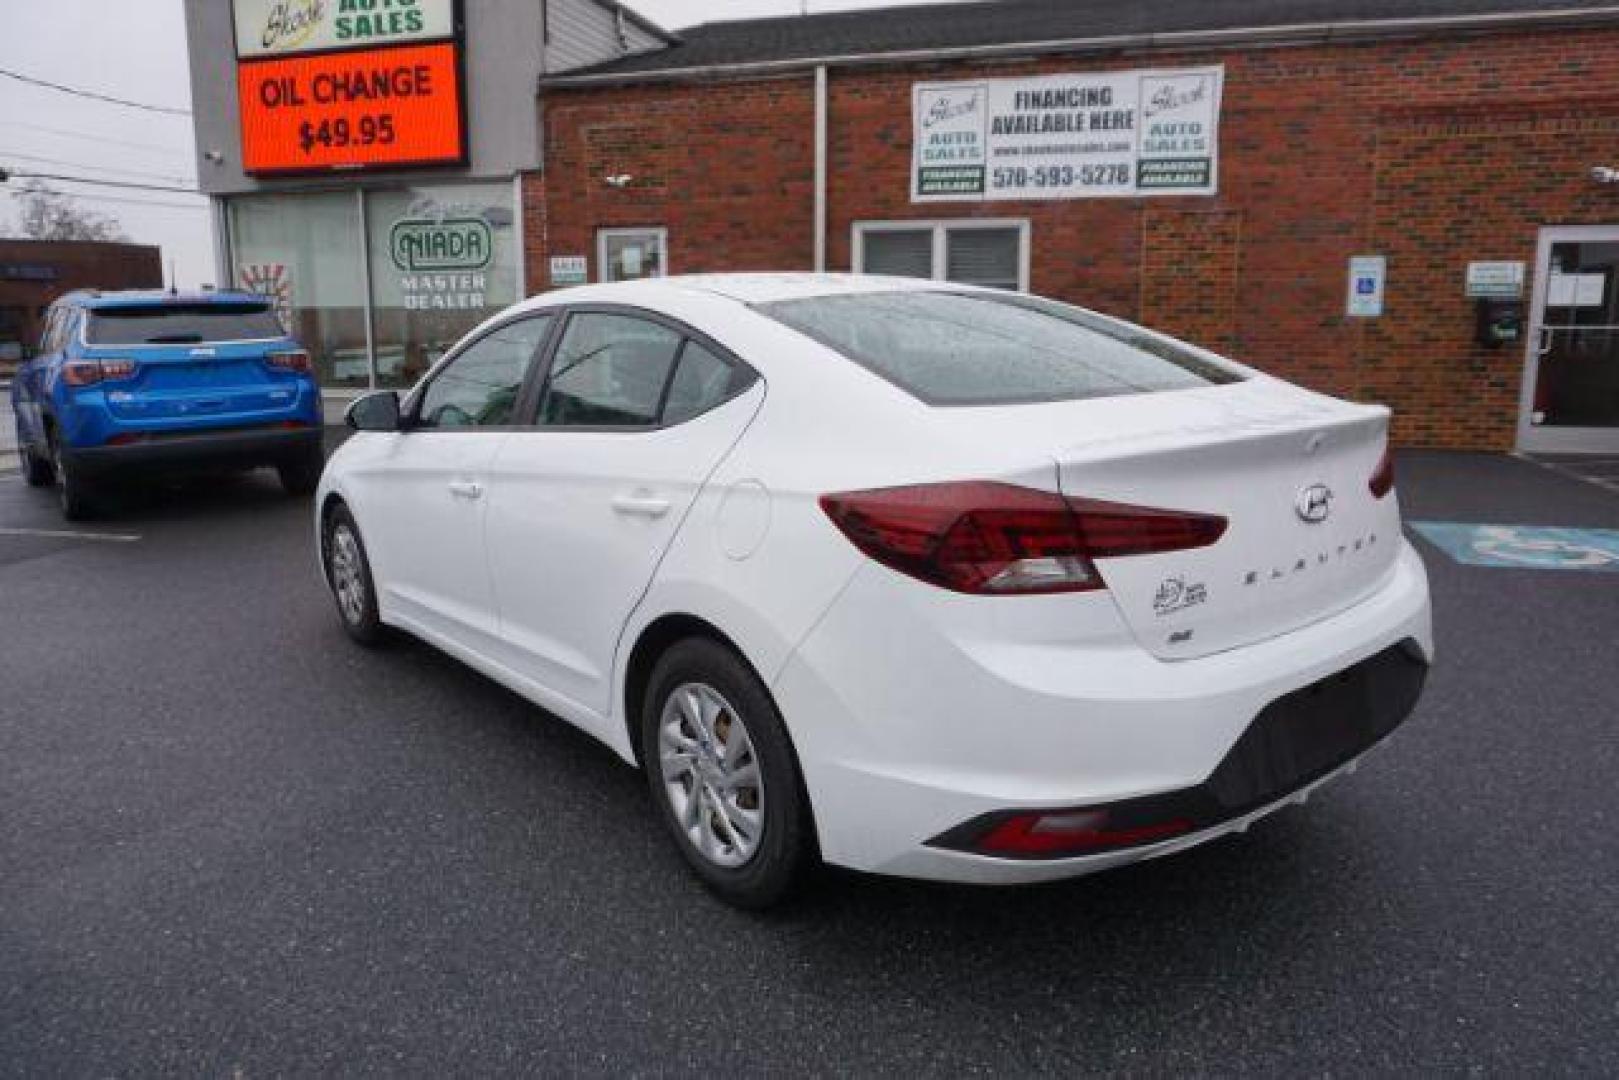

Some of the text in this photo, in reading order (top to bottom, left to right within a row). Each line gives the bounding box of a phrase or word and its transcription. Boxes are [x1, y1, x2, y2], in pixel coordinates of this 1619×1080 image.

[335, 10, 423, 39] SALES
[260, 66, 432, 108] OIL CHANGE
[1014, 86, 1112, 110] FINANCING
[300, 114, 394, 153] $49.95
[991, 111, 1134, 135] AVAILABLE HERE
[401, 274, 485, 291] MASTER
[404, 293, 484, 309] DEALER
